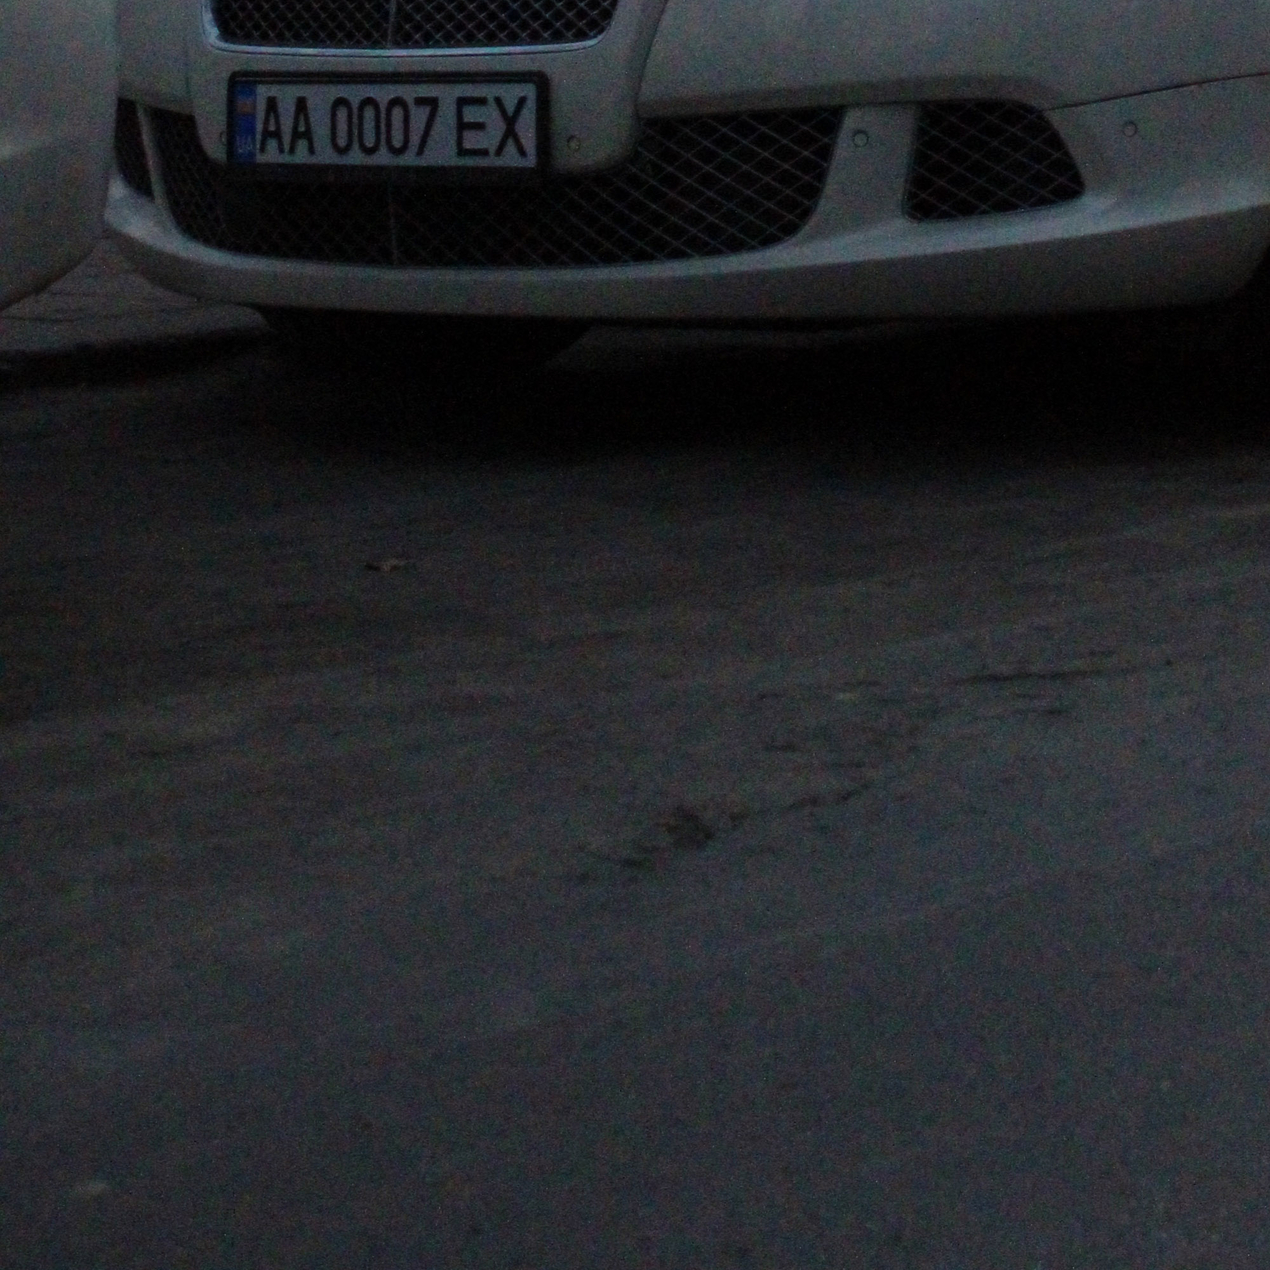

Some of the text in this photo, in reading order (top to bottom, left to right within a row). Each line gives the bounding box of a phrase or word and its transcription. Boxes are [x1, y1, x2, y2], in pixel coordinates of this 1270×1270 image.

[258, 95, 529, 158] AA 0007 EX
